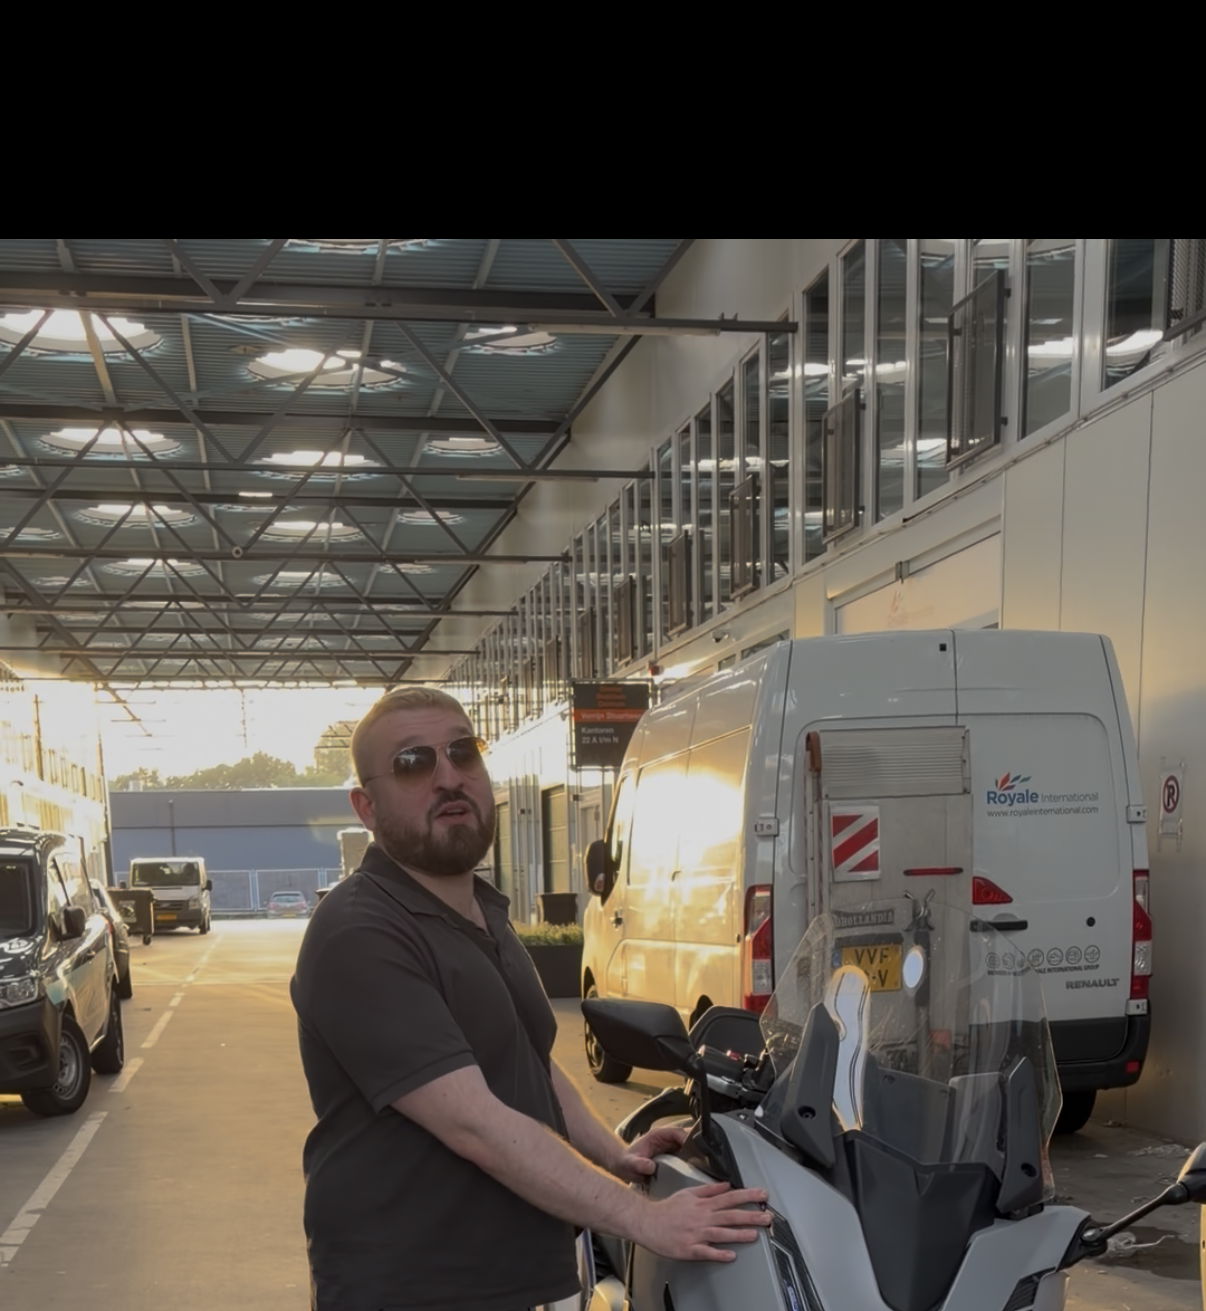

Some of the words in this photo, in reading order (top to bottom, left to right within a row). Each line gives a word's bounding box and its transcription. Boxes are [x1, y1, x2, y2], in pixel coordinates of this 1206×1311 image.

[582, 736, 591, 744] 22
[592, 736, 598, 744] A
[613, 736, 619, 744] N
[987, 789, 1038, 806] Royale
[1041, 792, 1099, 803] International
[987, 806, 1099, 817] www.royaleinternational.com
[832, 911, 893, 927] DHOLLANDIA
[1066, 978, 1120, 990] RENAULT
